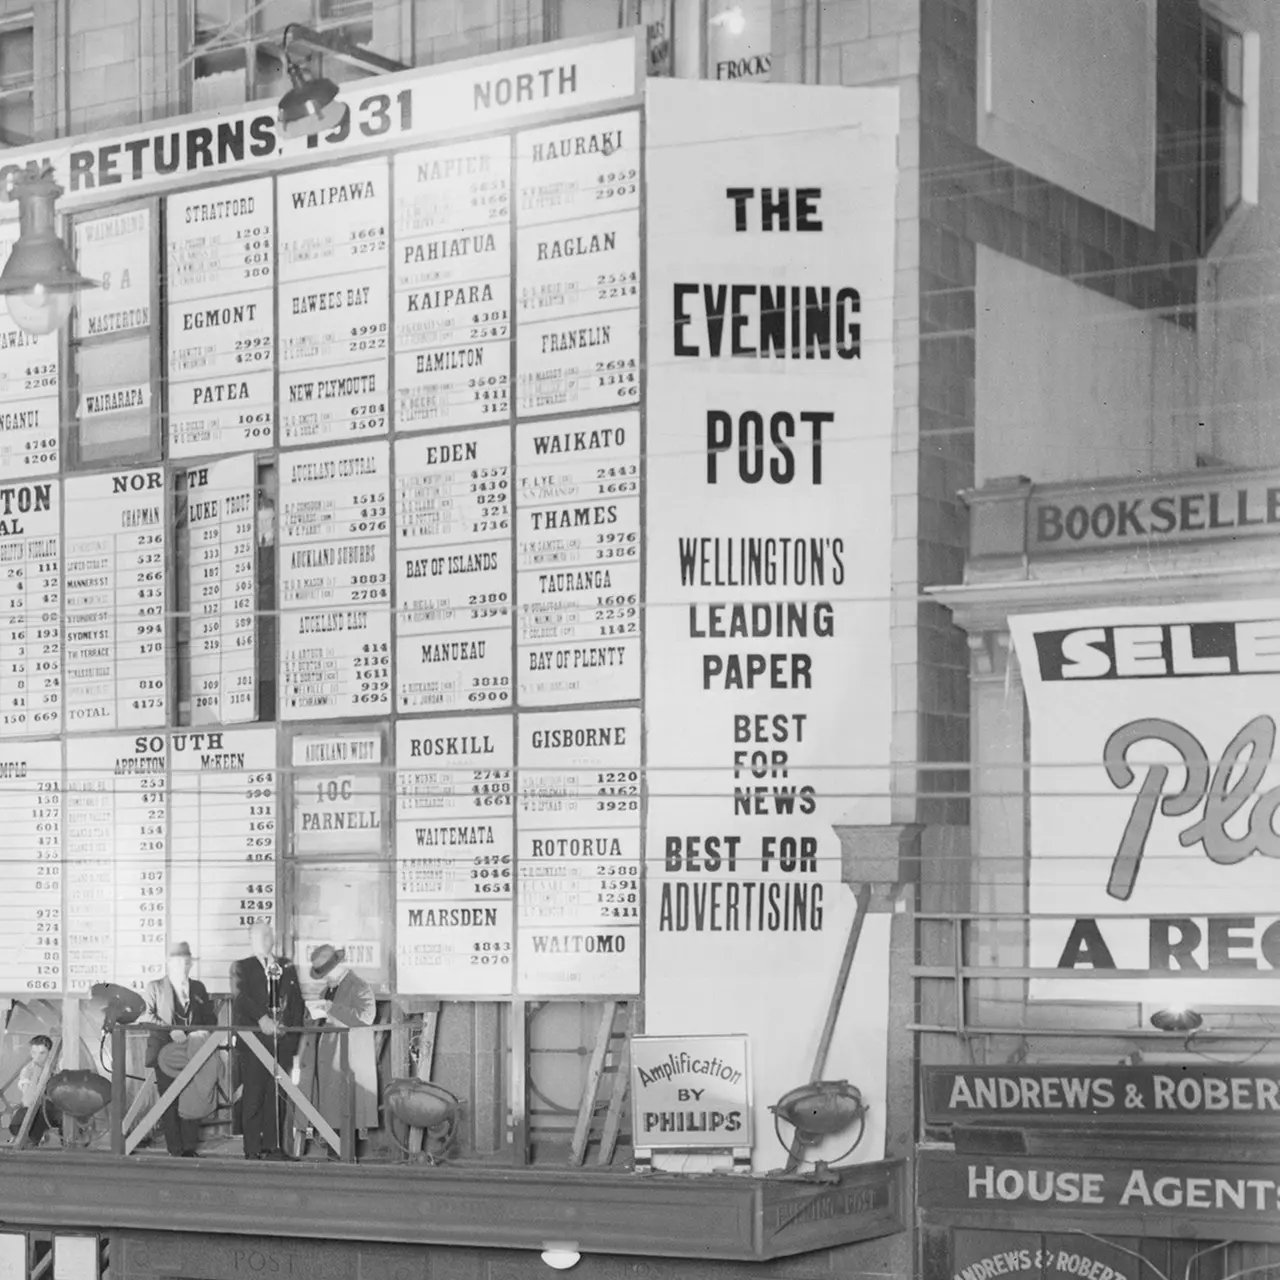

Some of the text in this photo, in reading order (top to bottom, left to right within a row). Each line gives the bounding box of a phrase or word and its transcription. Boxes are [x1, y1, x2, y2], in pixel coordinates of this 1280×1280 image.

[70, 113, 283, 189] RETURNS,
[473, 63, 577, 110] NORTH
[532, 130, 624, 162] HAURAKI
[292, 181, 375, 209] WAIPAWA
[185, 196, 255, 223] STRATFORD
[727, 188, 823, 231] THE
[674, 283, 861, 360] EVENING
[426, 441, 477, 465] EDEN
[533, 428, 625, 457] WAIKATO
[706, 410, 834, 484] POST
[531, 505, 618, 530] THAMES
[406, 552, 498, 578] BAY OF ISLANDS
[679, 537, 844, 586] WELLINGTON'S
[539, 570, 611, 594] TAURANGA
[690, 602, 834, 638] LEADING
[421, 641, 486, 663] MANUKAU
[529, 647, 625, 671] BAY OF PLENTY
[703, 653, 812, 690] PAPER
[532, 728, 626, 749] GISBORNE
[734, 714, 807, 743] BEST
[135, 733, 224, 754] SOUTH
[411, 736, 494, 756] ROSKILL
[734, 750, 788, 779] FOR
[734, 785, 816, 815] NEWS
[302, 811, 380, 829] PARNELL
[416, 826, 494, 846] WAITEMATA
[532, 838, 622, 856] ROTORUA
[665, 835, 818, 872] BEST FOR
[408, 908, 498, 927] MARSDEN
[660, 882, 823, 932] ADVERTISING
[532, 935, 626, 953] WAITOMO
[1057, 918, 1117, 968] A
[638, 1052, 742, 1088] Amplification
[679, 1088, 705, 1101] BY
[949, 1075, 1280, 1110] ANDREWS & ROBER
[643, 1111, 741, 1132] PHILIPS
[968, 1165, 1280, 1210] HOUSE AGENT
